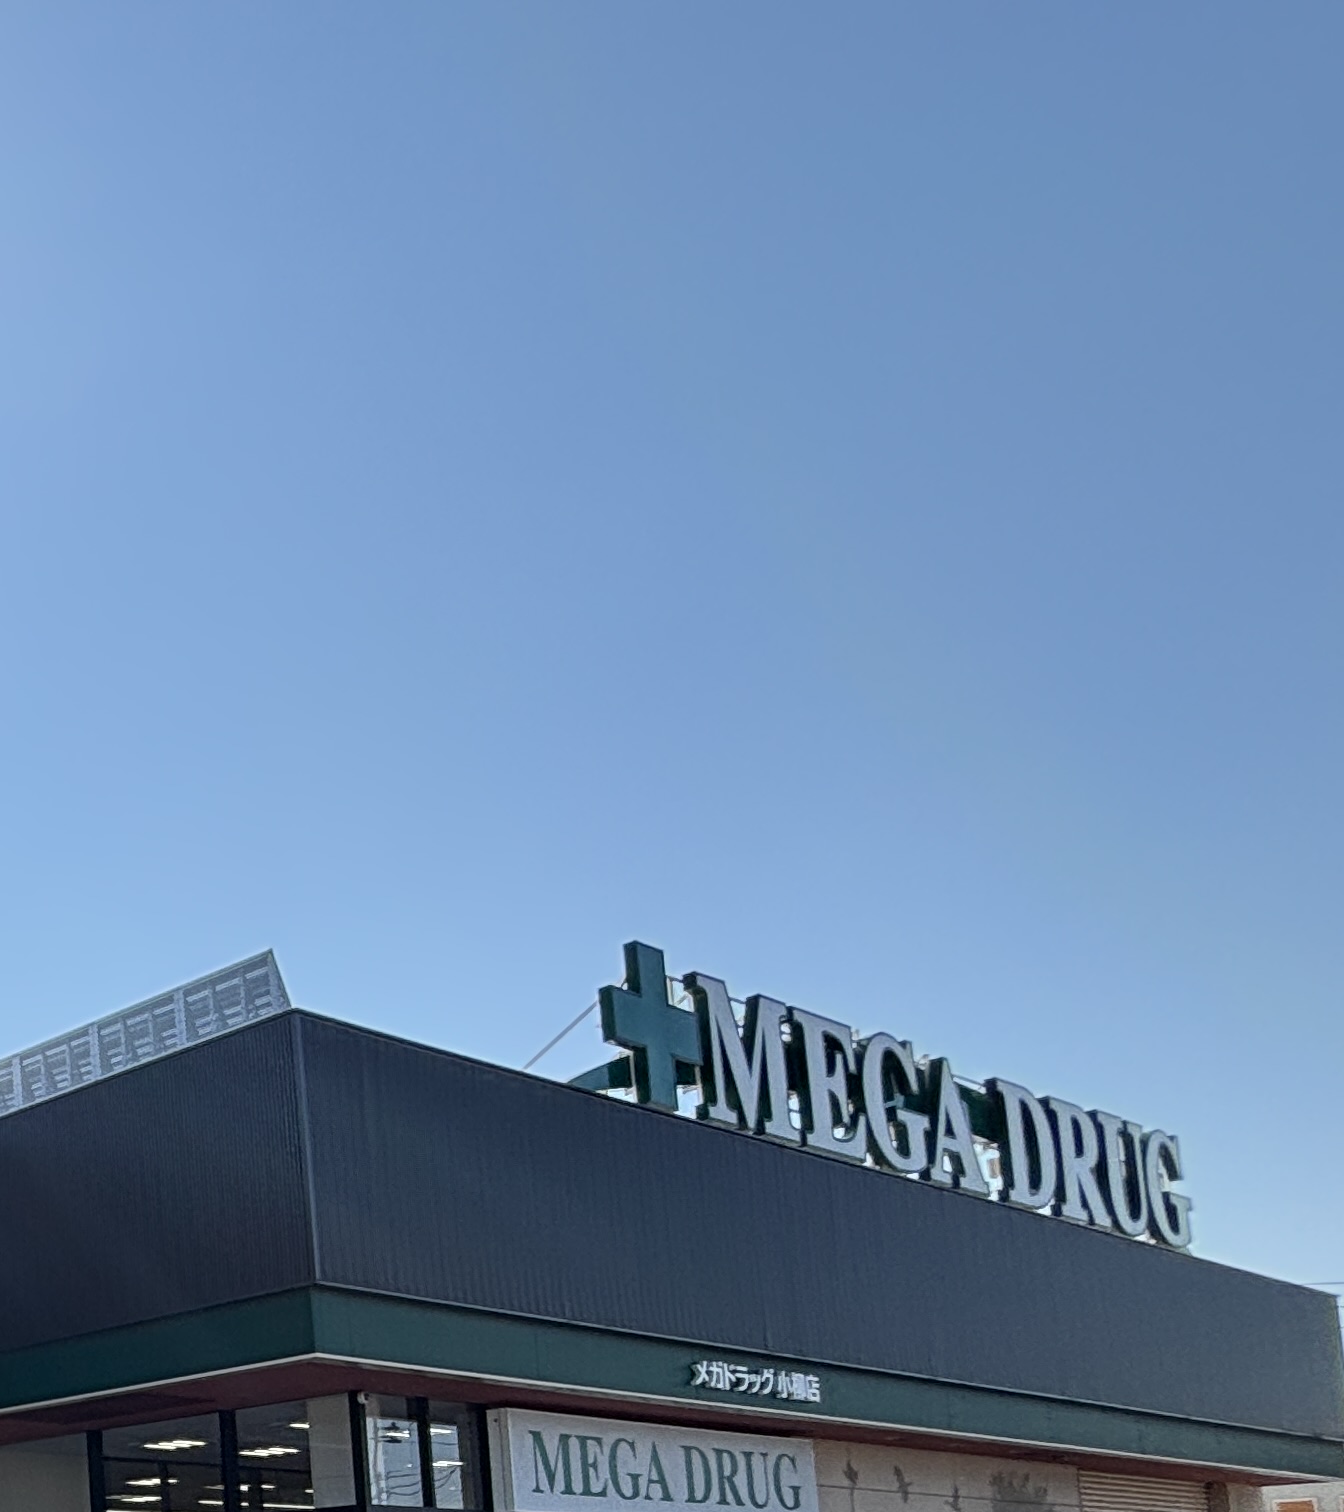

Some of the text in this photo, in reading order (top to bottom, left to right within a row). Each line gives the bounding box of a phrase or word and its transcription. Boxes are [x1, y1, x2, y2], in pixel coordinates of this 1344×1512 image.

[683, 971, 1193, 1249] MEGA DRUG
[692, 1360, 775, 1396] メガドラッグ
[528, 1430, 802, 1512] MEGA DRUG
